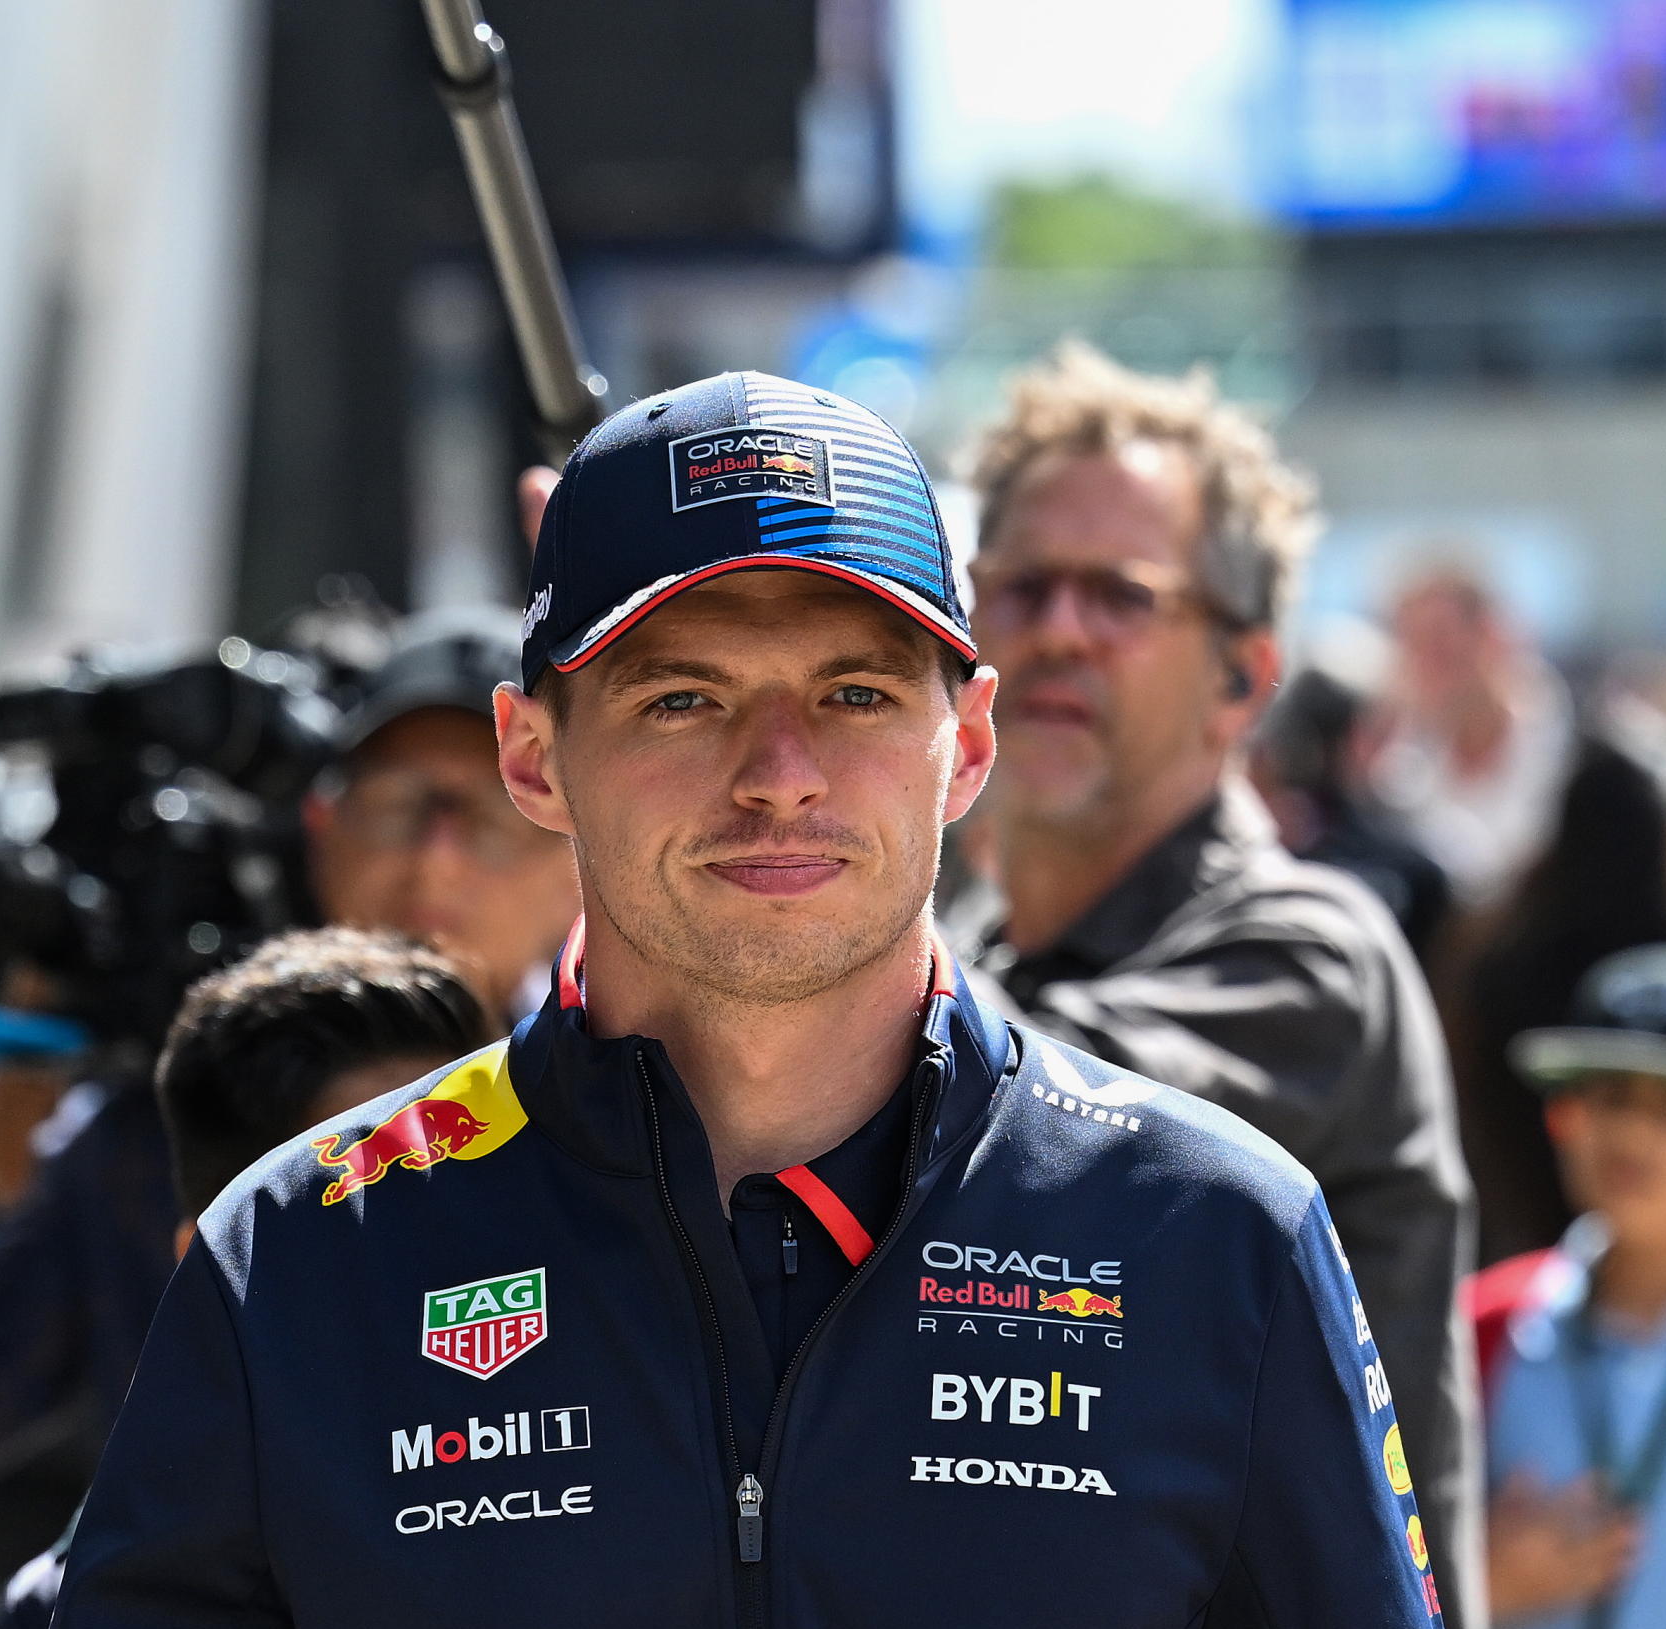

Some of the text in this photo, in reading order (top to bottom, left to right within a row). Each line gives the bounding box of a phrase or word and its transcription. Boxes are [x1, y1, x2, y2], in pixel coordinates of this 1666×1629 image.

[688, 435, 813, 460] ORACLE
[689, 454, 757, 479] Red Bull
[690, 476, 817, 496] RACING
[922, 1241, 1123, 1285] ORACLE
[436, 1279, 533, 1323] TAG
[919, 1276, 1031, 1310] Red Bull
[431, 1316, 539, 1371] HEUER
[918, 1317, 1123, 1350] RACING
[931, 1371, 1101, 1432] BYBIT
[391, 1411, 572, 1474] Mobil 1
[910, 1456, 1117, 1497] HONDA
[395, 1485, 594, 1535] ORACLE
